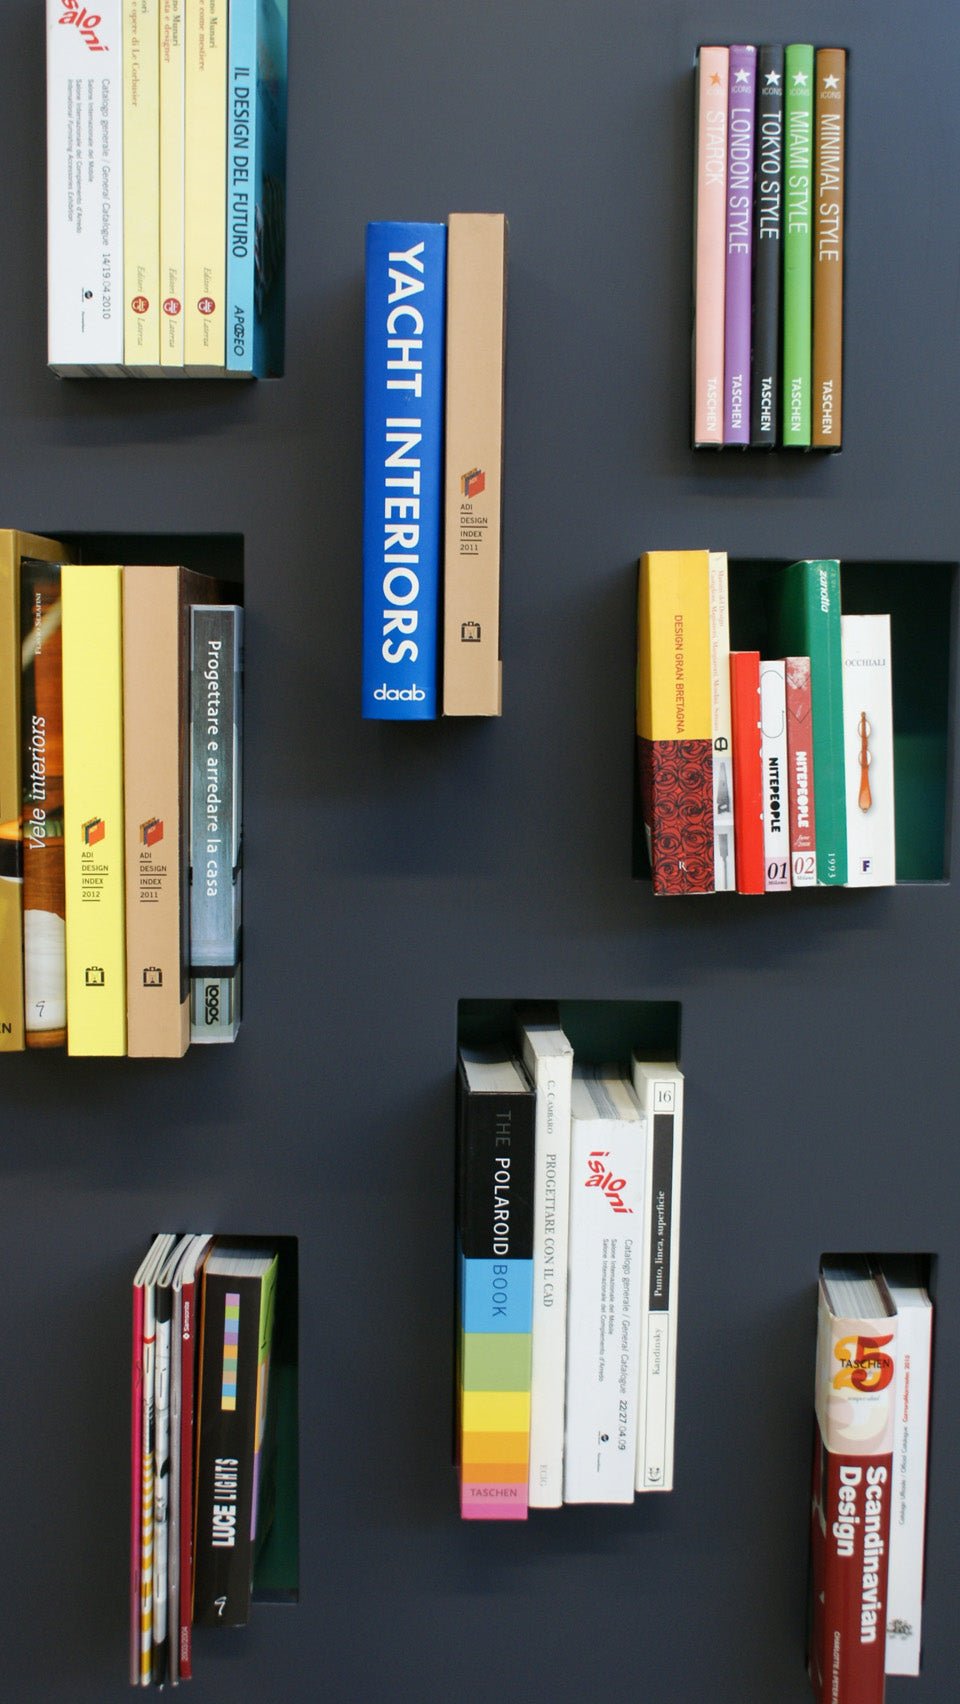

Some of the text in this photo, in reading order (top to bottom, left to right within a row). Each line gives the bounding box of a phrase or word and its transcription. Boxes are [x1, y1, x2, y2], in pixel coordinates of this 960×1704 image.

[129, 9, 138, 35] opere
[132, 37, 139, 46] di
[172, 15, 180, 46] Munari
[209, 17, 218, 48] Munari
[132, 49, 140, 60] Le
[162, 24, 171, 63] designer
[100, 79, 111, 117] Catalogo
[131, 62, 140, 107] Corbusier
[731, 86, 752, 94] ICONS
[762, 88, 783, 96] ICONS
[789, 88, 810, 96] ICONS
[820, 91, 841, 99] ICONS
[100, 120, 111, 156] generale
[705, 109, 725, 186] STARCK
[100, 166, 111, 200] General
[232, 67, 250, 258] IL DESIGN DEL FUTURO
[728, 108, 750, 254] LONDON STYLE
[760, 110, 782, 240] TOKYO STYLE
[788, 111, 809, 235] MIAMI STYLE
[819, 114, 840, 262] MINIMAL STYLE
[100, 202, 111, 246] Catalogue
[137, 266, 145, 346] Editori Laterza
[168, 268, 177, 348] Editori Laterza
[203, 267, 212, 346] Editori Laterza
[233, 305, 246, 357] APOGEO
[707, 377, 718, 432] TASCHEN
[731, 374, 743, 428] TASCHEN
[761, 376, 772, 431] TASCHEN
[791, 377, 802, 432] TASCHEN
[821, 380, 833, 434] TASCHEN
[382, 241, 425, 664] YACHT INTERIORS
[460, 503, 473, 511] ADI
[819, 570, 831, 613] zanotta
[674, 614, 686, 734] DESIGN GRAN BRETAGNA
[845, 658, 886, 667] OCCHIALI
[373, 682, 426, 702] daab
[29, 715, 47, 850] Vele interiors
[204, 640, 222, 897] Progettare e arredare la casa
[795, 751, 809, 828] NITEPEOPLE
[768, 757, 781, 832] NITEPEOPLE
[767, 862, 788, 880] 01
[794, 857, 814, 875] 02
[827, 852, 837, 879] 1993
[863, 860, 871, 872] F
[658, 1090, 672, 1103] 16
[492, 1110, 511, 1317] THE POLAROID BOOK
[543, 1154, 556, 1307] PROGETTARE CON IL CAD
[610, 1239, 618, 1259] Salone
[622, 1239, 633, 1275] Catalogo
[653, 1190, 666, 1297] Punto, linea, superficie
[600, 1260, 608, 1302] Internazionale
[609, 1260, 617, 1302] Internazionale
[621, 1277, 631, 1311] generale
[599, 1314, 607, 1355] Complemento
[620, 1320, 631, 1351] General
[652, 1328, 663, 1376] Kandinsky
[598, 1357, 607, 1382] d'Arredo
[618, 1354, 629, 1394] Catalogue
[832, 1334, 895, 1393] 25
[839, 1358, 890, 1369] TASCHEN
[212, 1458, 239, 1547] LUCE LIGHTS
[470, 1488, 518, 1497] TASCHEN
[832, 1466, 862, 1557] Design
[860, 1466, 888, 1644] Scandinavian
[833, 1631, 841, 1670] CHARLOTTE
